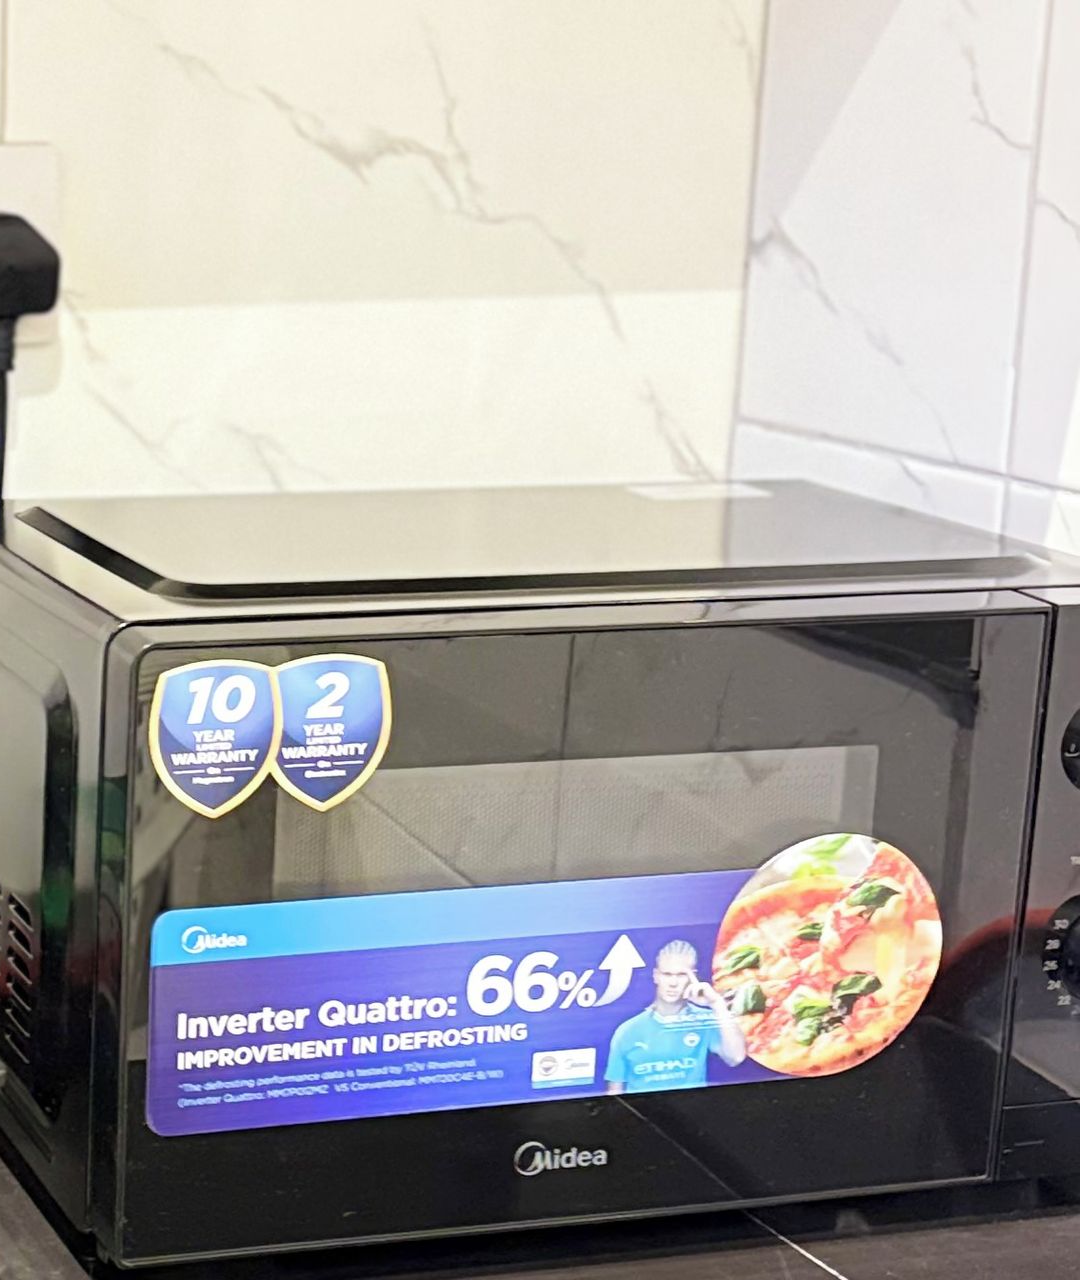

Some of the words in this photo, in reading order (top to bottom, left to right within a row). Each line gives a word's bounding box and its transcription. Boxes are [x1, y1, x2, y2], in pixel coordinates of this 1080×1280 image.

[187, 674, 256, 725] 10
[305, 671, 350, 719] 2
[192, 729, 235, 743] YEAR
[303, 723, 344, 737] YEAR
[170, 749, 259, 766] WARRANTY
[281, 742, 368, 760] WARRANTY
[181, 925, 248, 954] Midea
[177, 1006, 309, 1040] Inverter
[319, 995, 457, 1028] Quattro:
[466, 951, 597, 1017] 66%
[177, 1037, 347, 1071] IMPROVEMENT
[352, 1034, 378, 1055] IN
[383, 1023, 528, 1052] DEFROSTING
[514, 1141, 608, 1176] Midea
